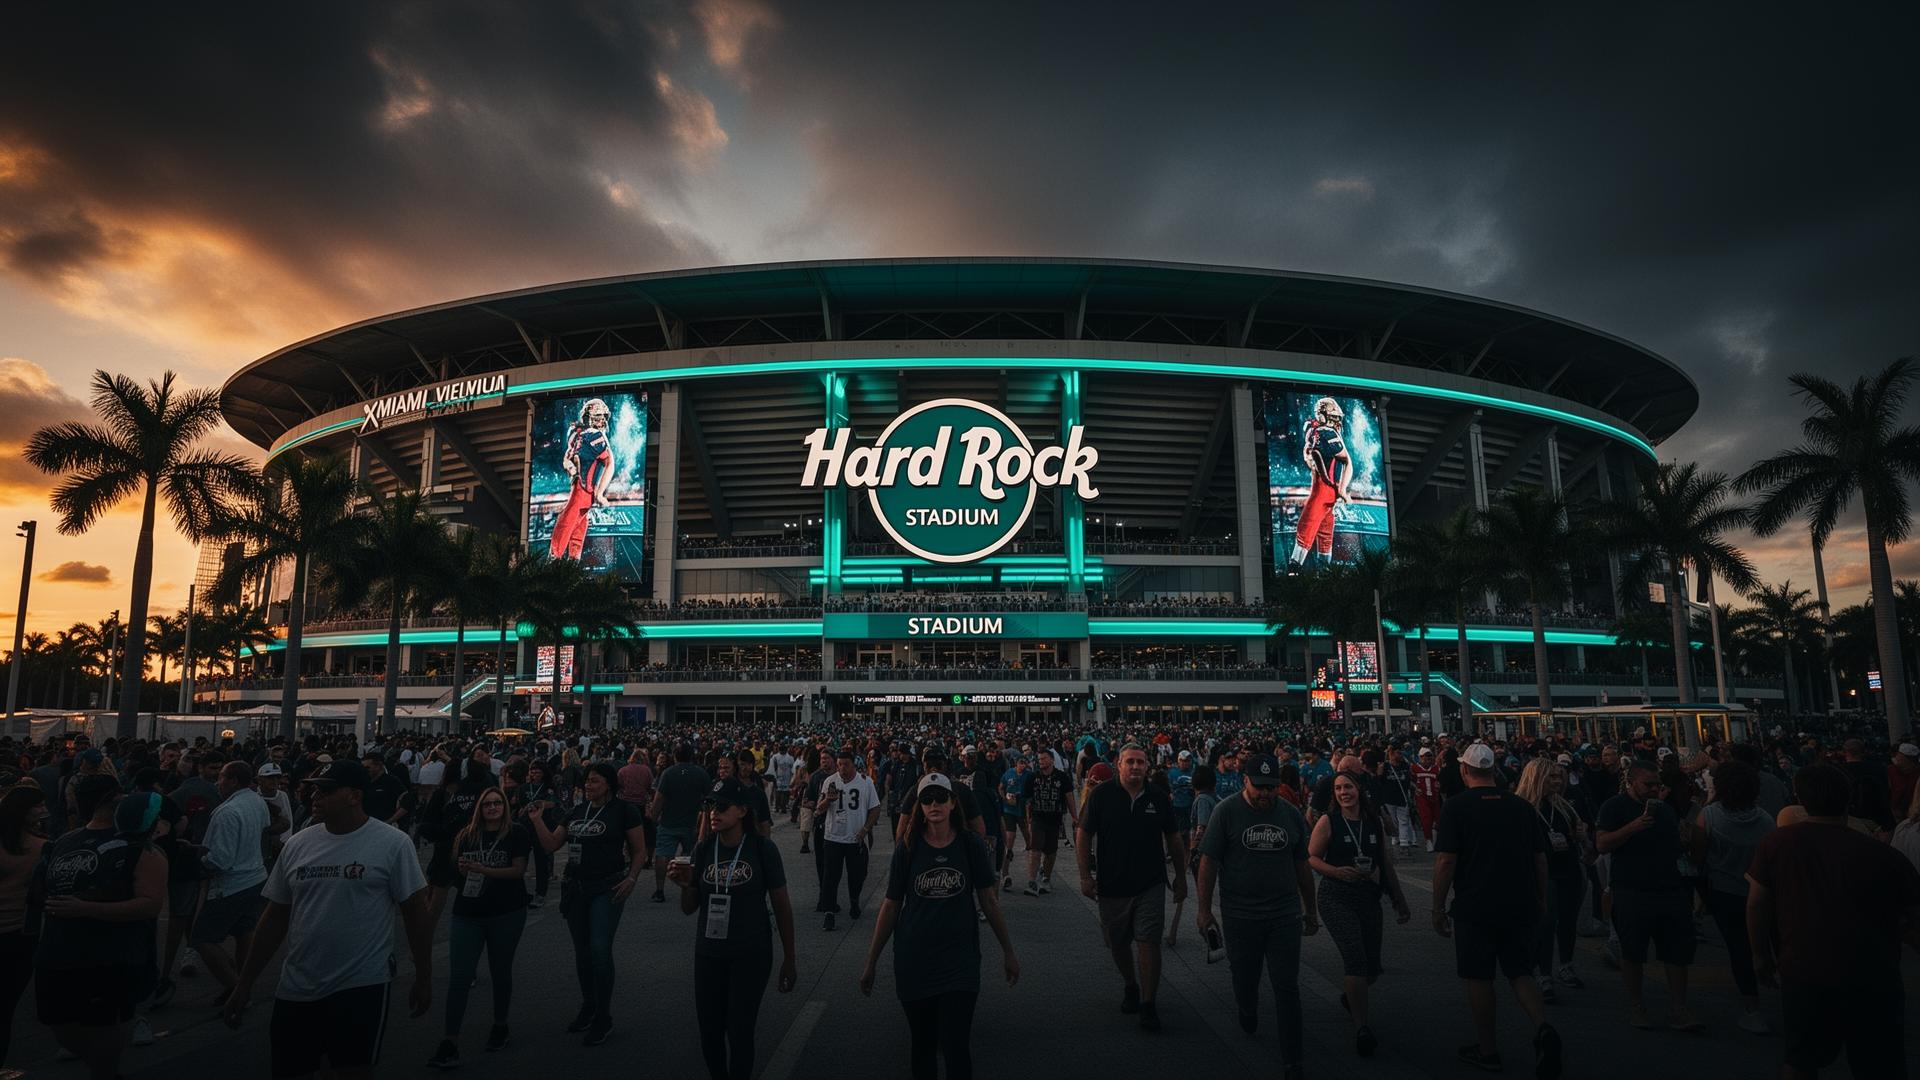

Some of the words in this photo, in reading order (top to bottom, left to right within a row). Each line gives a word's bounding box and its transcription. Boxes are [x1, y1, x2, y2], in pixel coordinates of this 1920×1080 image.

[800, 426, 952, 488] Hard
[958, 425, 1100, 500] Rock
[905, 508, 999, 526] STADIUM
[908, 616, 1003, 635] STADIUM
[838, 788, 860, 810] 13
